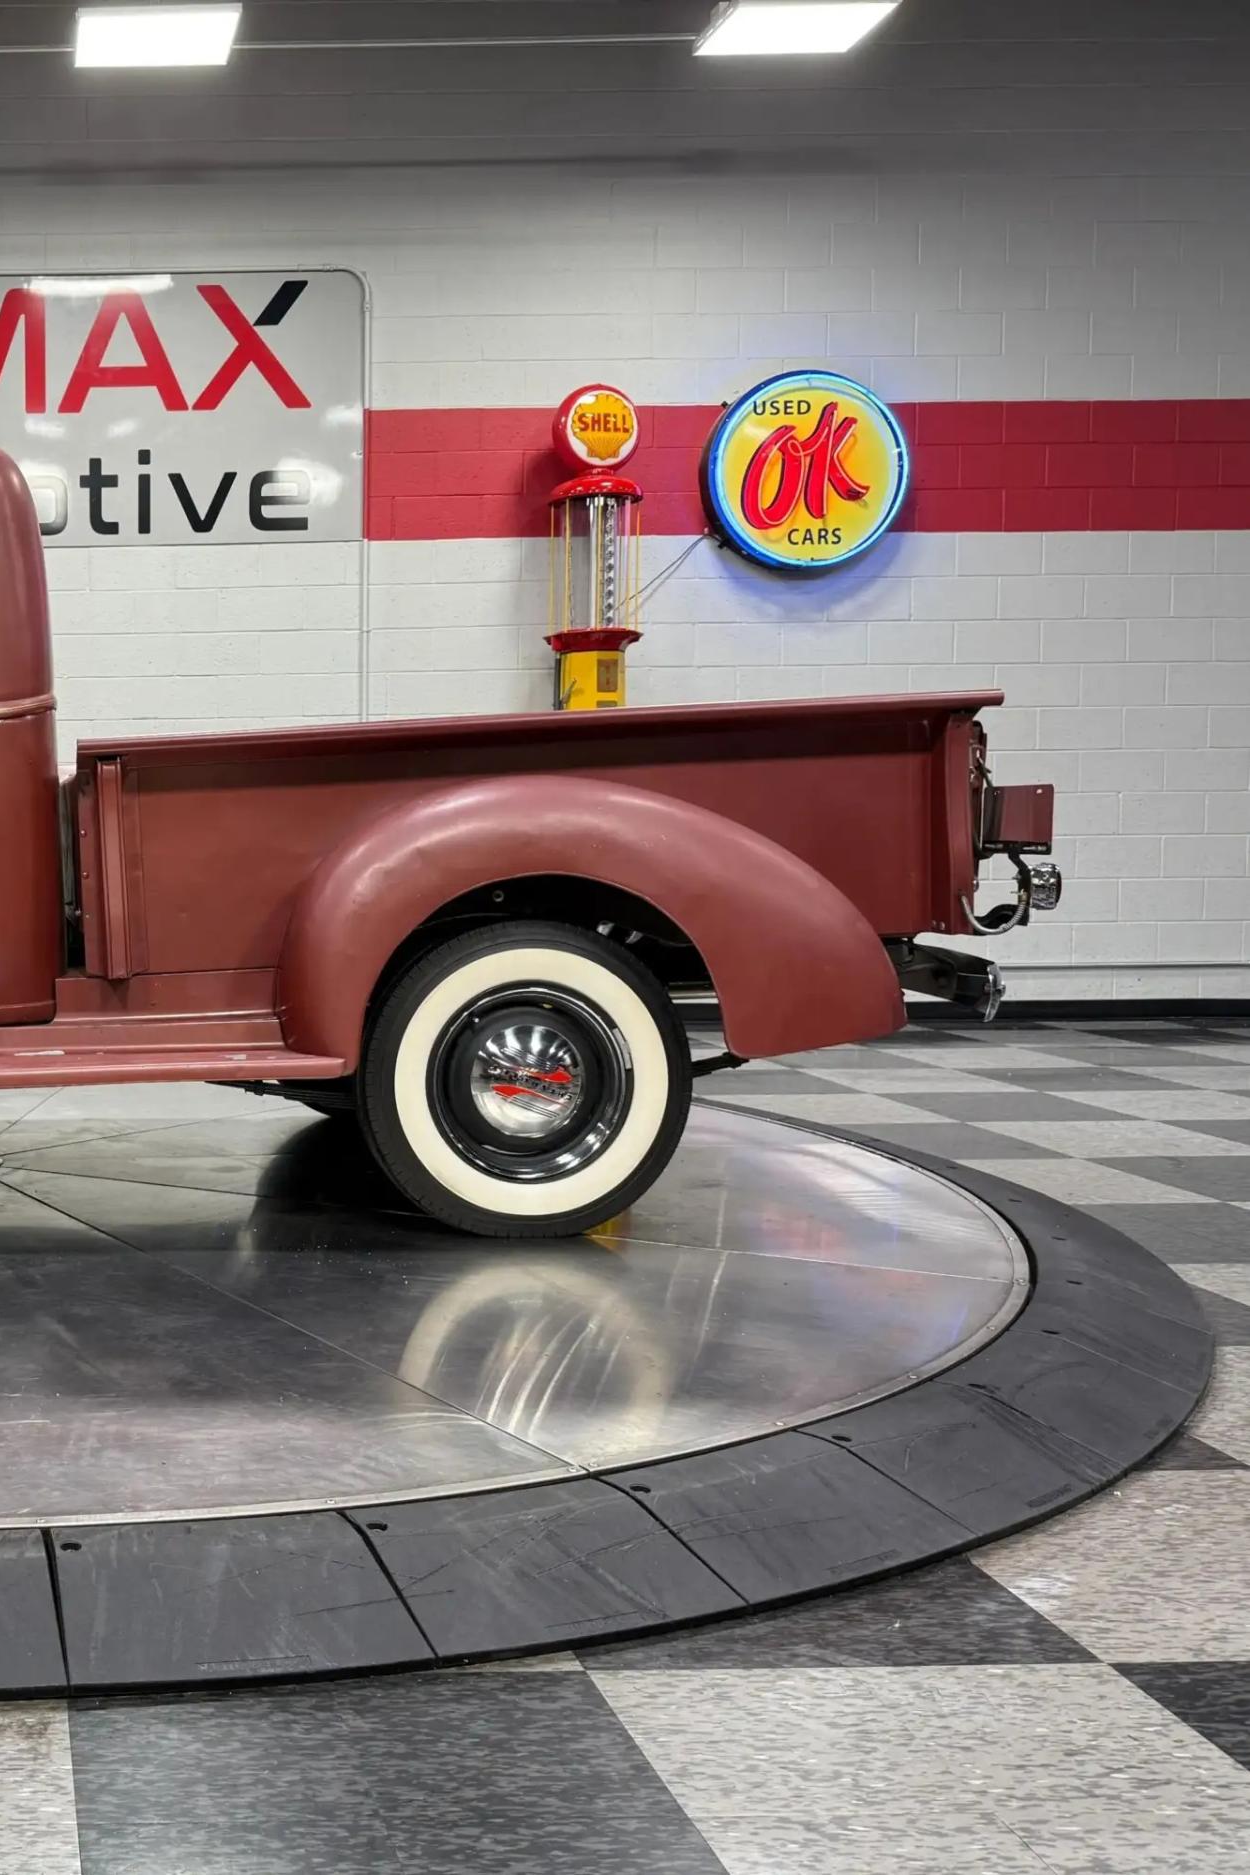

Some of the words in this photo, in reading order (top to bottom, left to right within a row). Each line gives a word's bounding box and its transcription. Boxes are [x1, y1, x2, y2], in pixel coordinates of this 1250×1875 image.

[752, 399, 812, 416] USED
[577, 412, 630, 433] SHELL
[740, 401, 871, 530] OK
[787, 527, 843, 546] CARS
